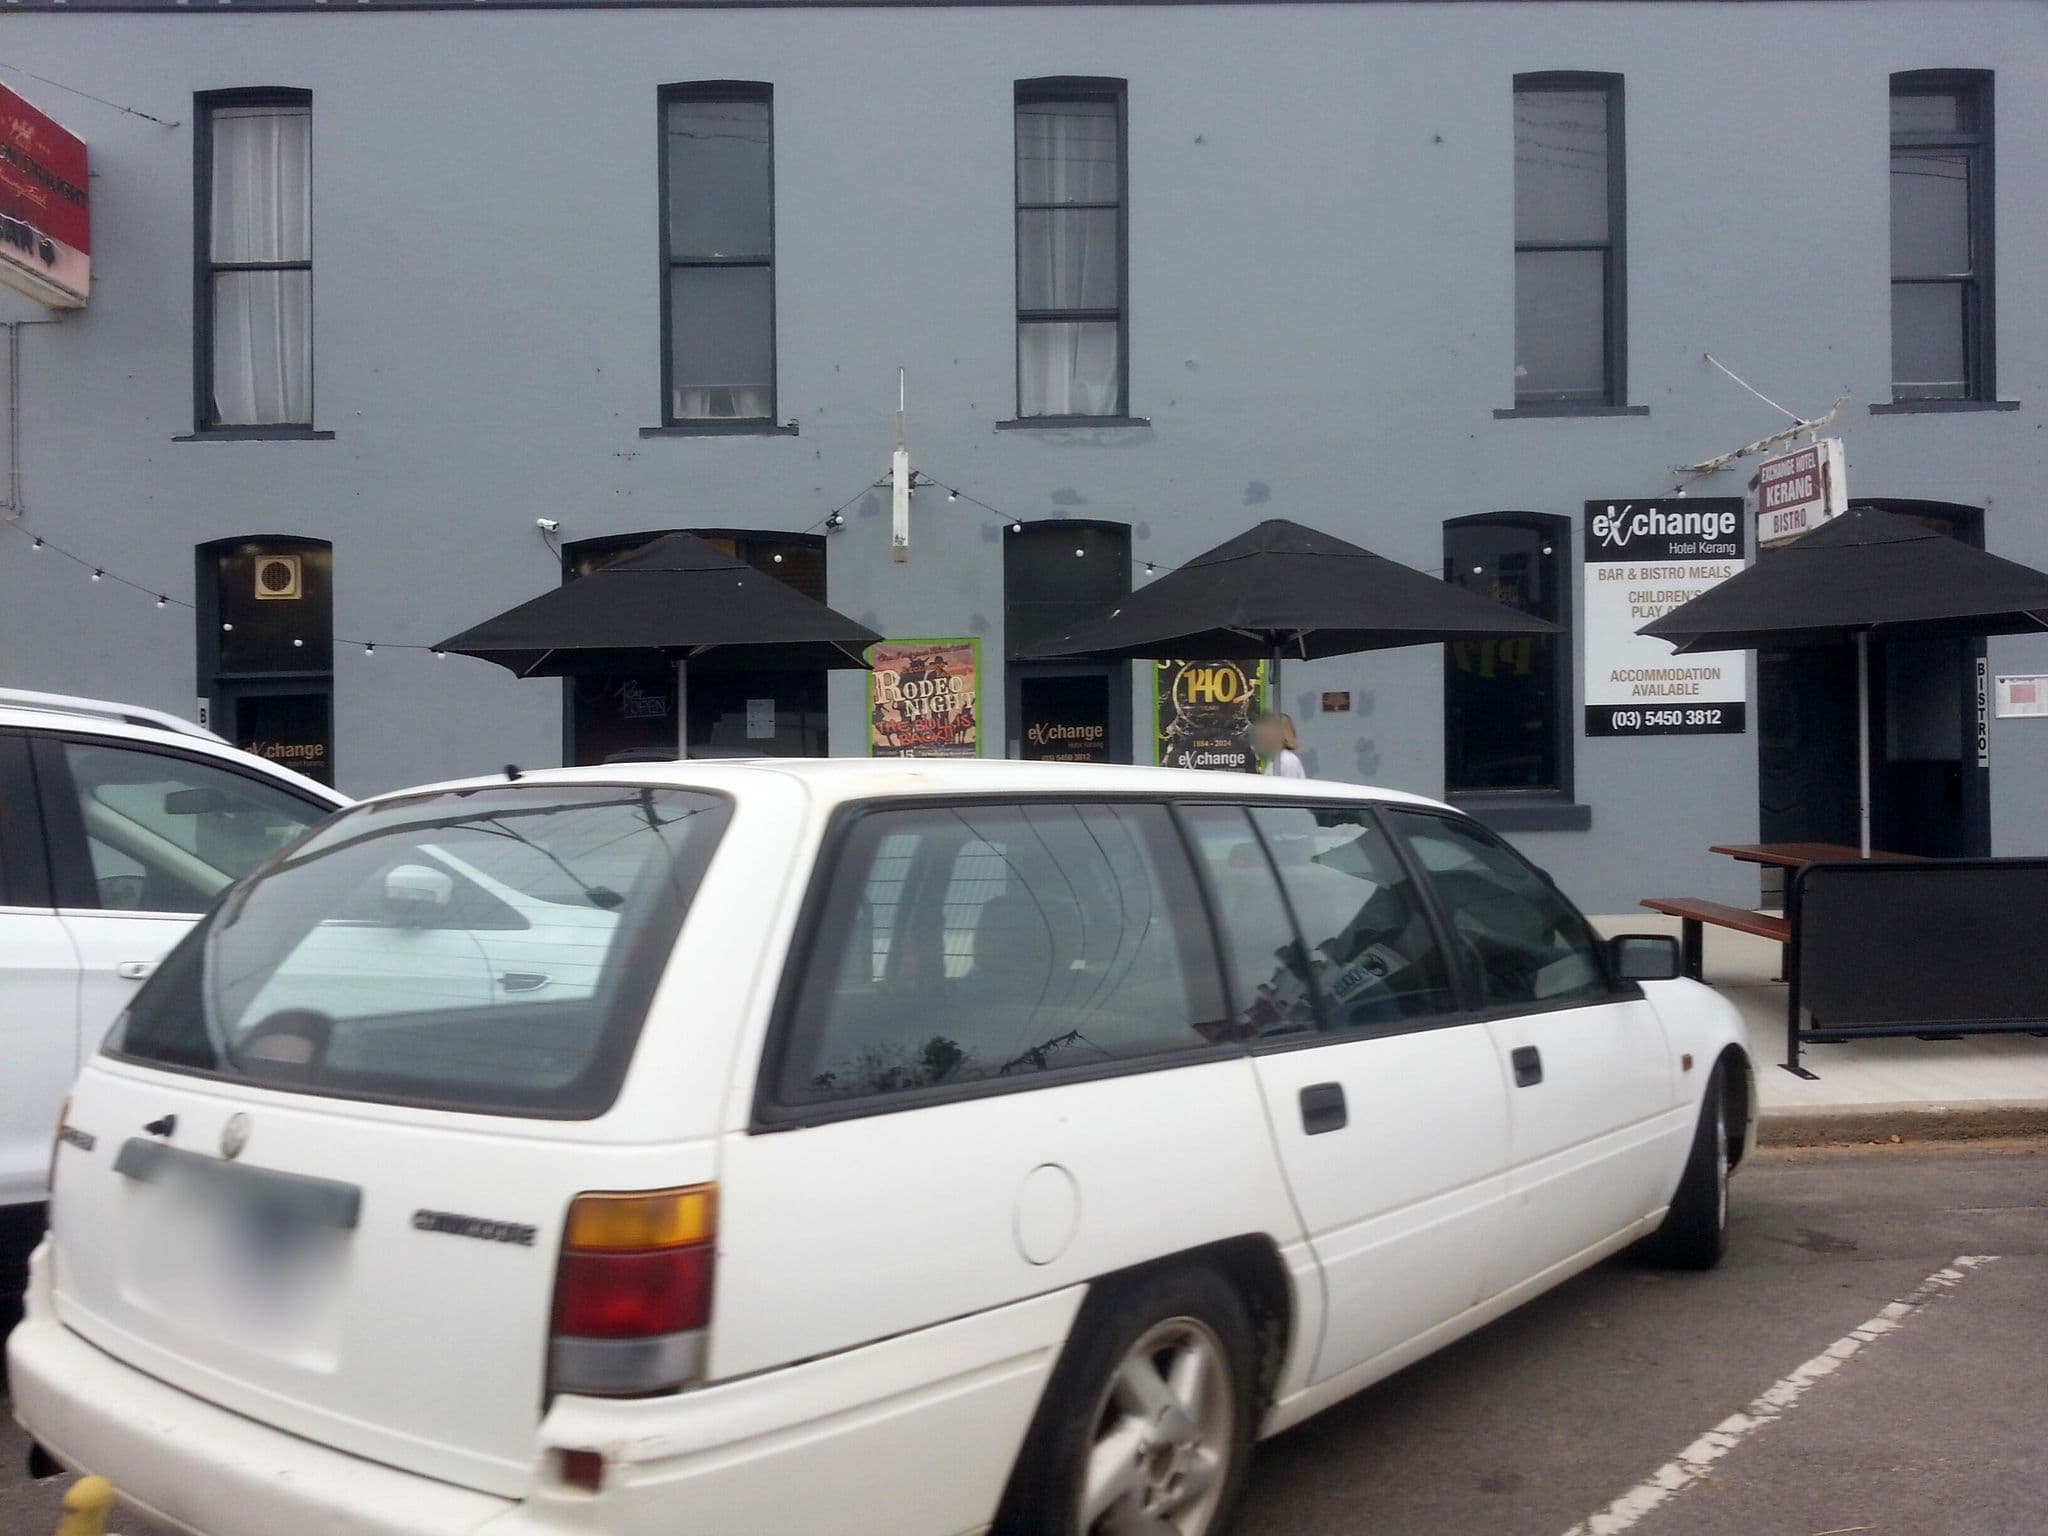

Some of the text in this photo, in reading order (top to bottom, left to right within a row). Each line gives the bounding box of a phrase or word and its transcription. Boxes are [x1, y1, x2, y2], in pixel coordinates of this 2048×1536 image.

[1762, 452, 1816, 483] EXCHANGE HOTEL
[1766, 475, 1813, 507] KERANG
[1773, 508, 1807, 534] BISTRO
[1669, 541, 1736, 556] Hotel Kerang
[1598, 566, 1731, 581] BAR & BISTRO MEALS
[1628, 590, 1702, 603] CHILDREN'S
[1632, 605, 1663, 618] PLAY
[1610, 668, 1721, 682] ACCOMMODATION
[872, 670, 963, 705] RODEO
[1184, 668, 1237, 703] 140
[1632, 683, 1700, 697] AVAILABLE
[904, 691, 976, 718] NIGHT
[879, 714, 972, 733] THE BULL IS
[1612, 710, 1722, 729] (03) 5450 3812
